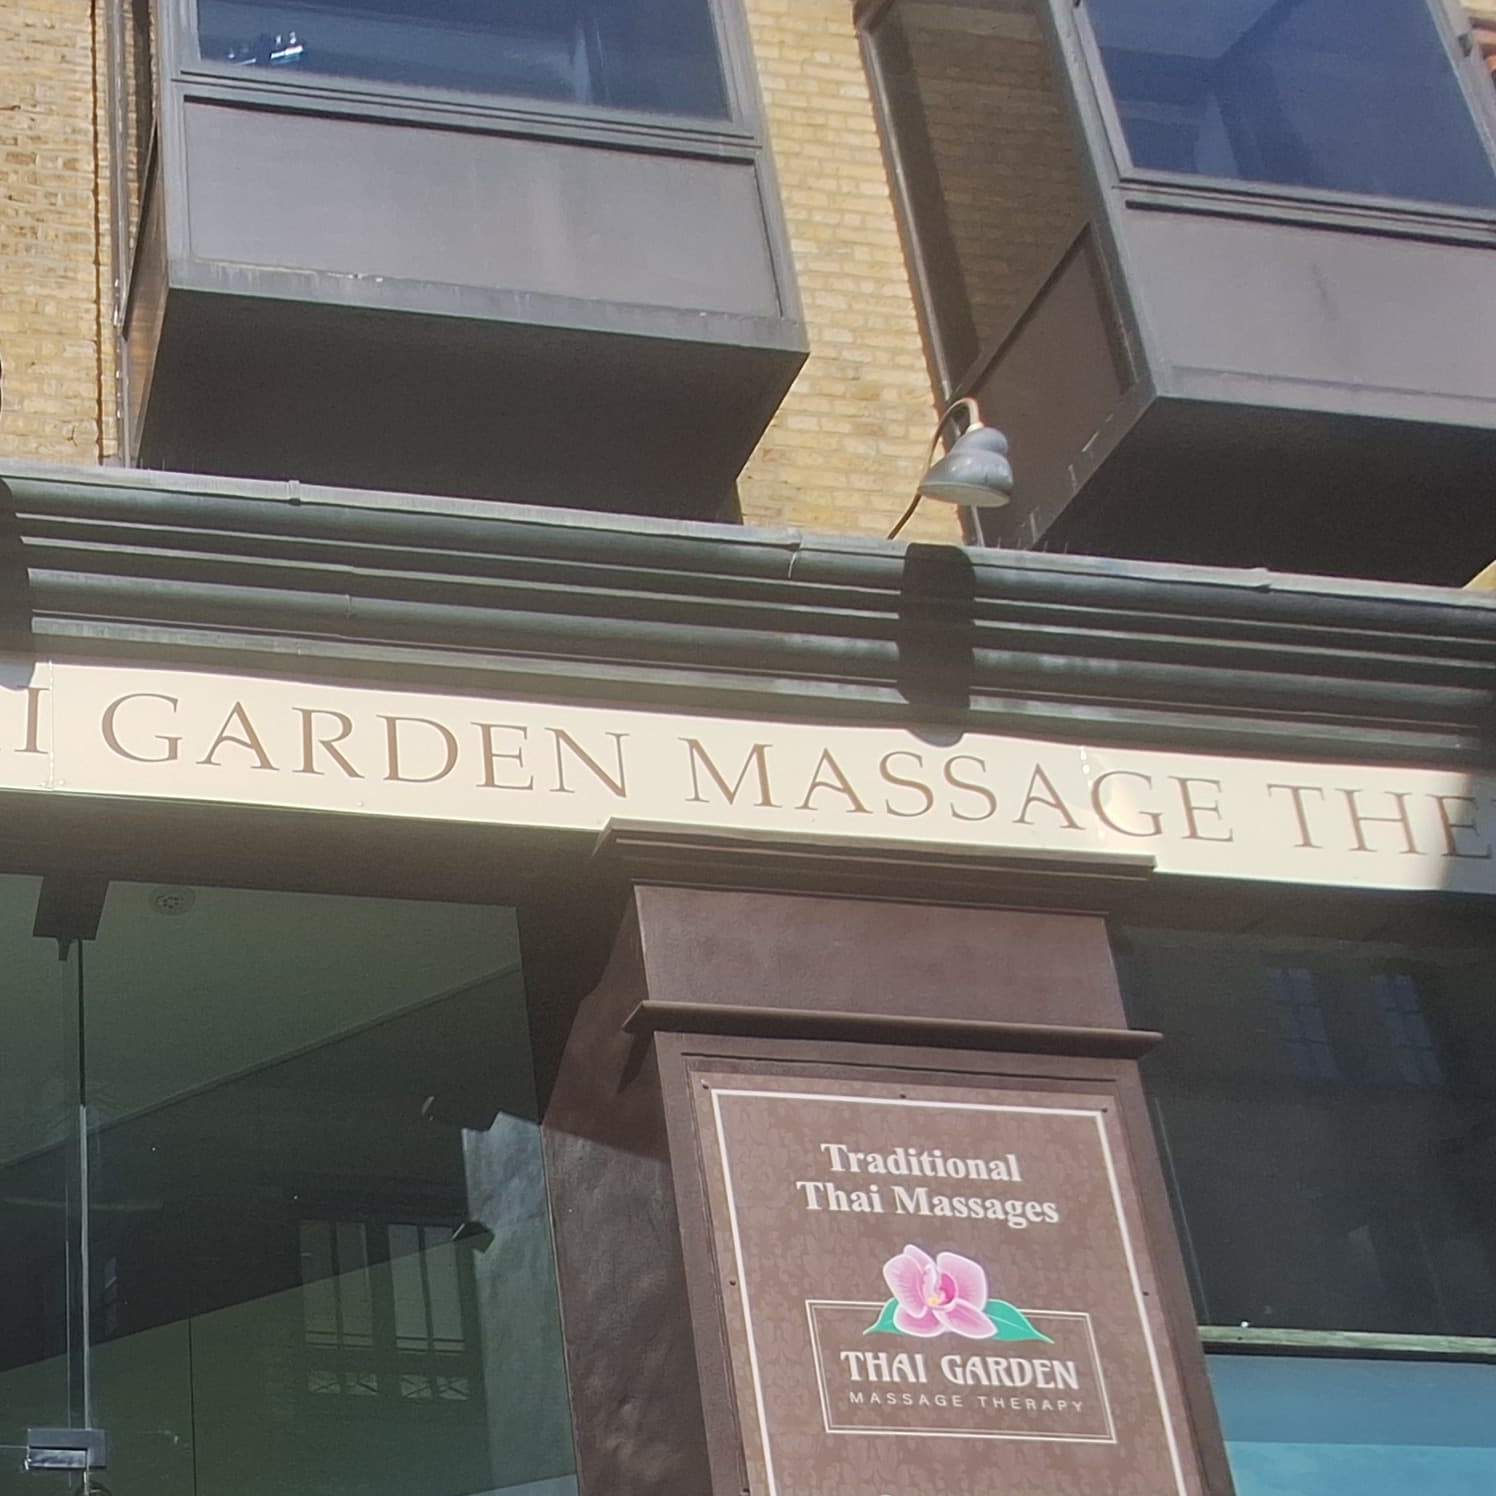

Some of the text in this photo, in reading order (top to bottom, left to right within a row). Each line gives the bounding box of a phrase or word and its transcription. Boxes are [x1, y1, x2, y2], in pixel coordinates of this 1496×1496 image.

[101, 692, 631, 798] GARDEN
[678, 736, 1235, 843] MASSAGE
[1267, 782, 1496, 860] THE
[820, 1143, 1023, 1182] Traditional
[795, 1181, 1060, 1229] Thai Massages
[840, 1351, 1079, 1390] THAI GARDEN
[848, 1391, 1084, 1413] MASSAGE THERAPY
